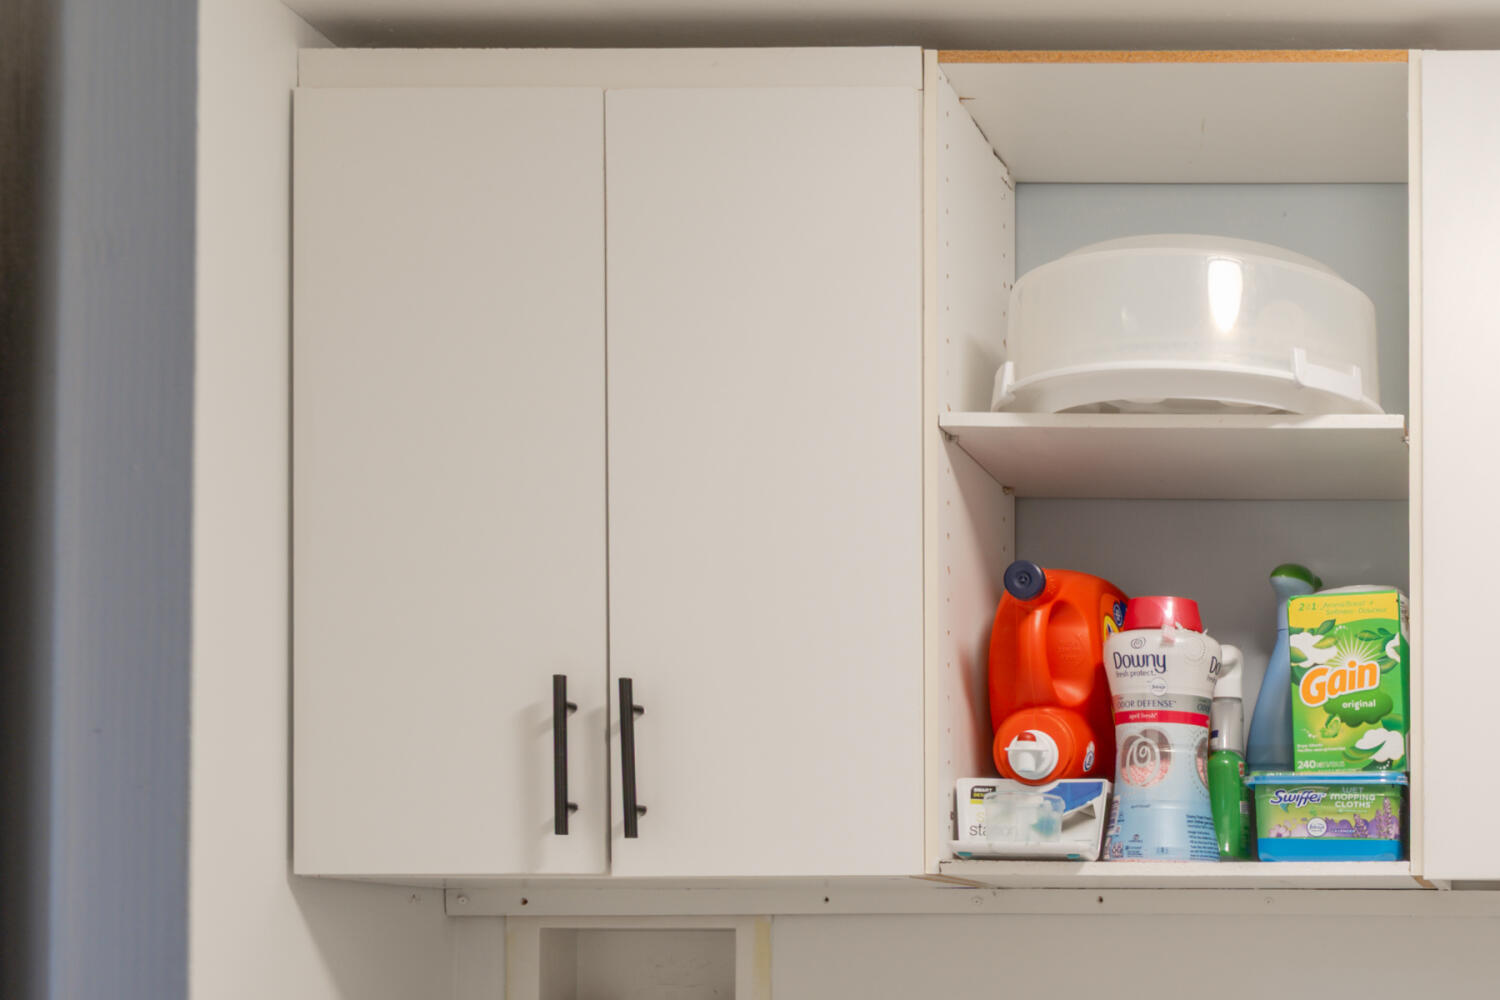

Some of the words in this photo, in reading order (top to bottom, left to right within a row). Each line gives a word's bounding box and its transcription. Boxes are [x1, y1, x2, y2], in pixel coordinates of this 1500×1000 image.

[1113, 651, 1167, 674] Downy
[1299, 658, 1380, 707] Gain
[1341, 699, 1377, 711] original
[1297, 760, 1317, 769] 240
[1342, 786, 1364, 794] WET
[1270, 789, 1327, 808] Swiffer
[1329, 793, 1376, 801] MOPPING
[1334, 800, 1371, 809] CLOTHS
